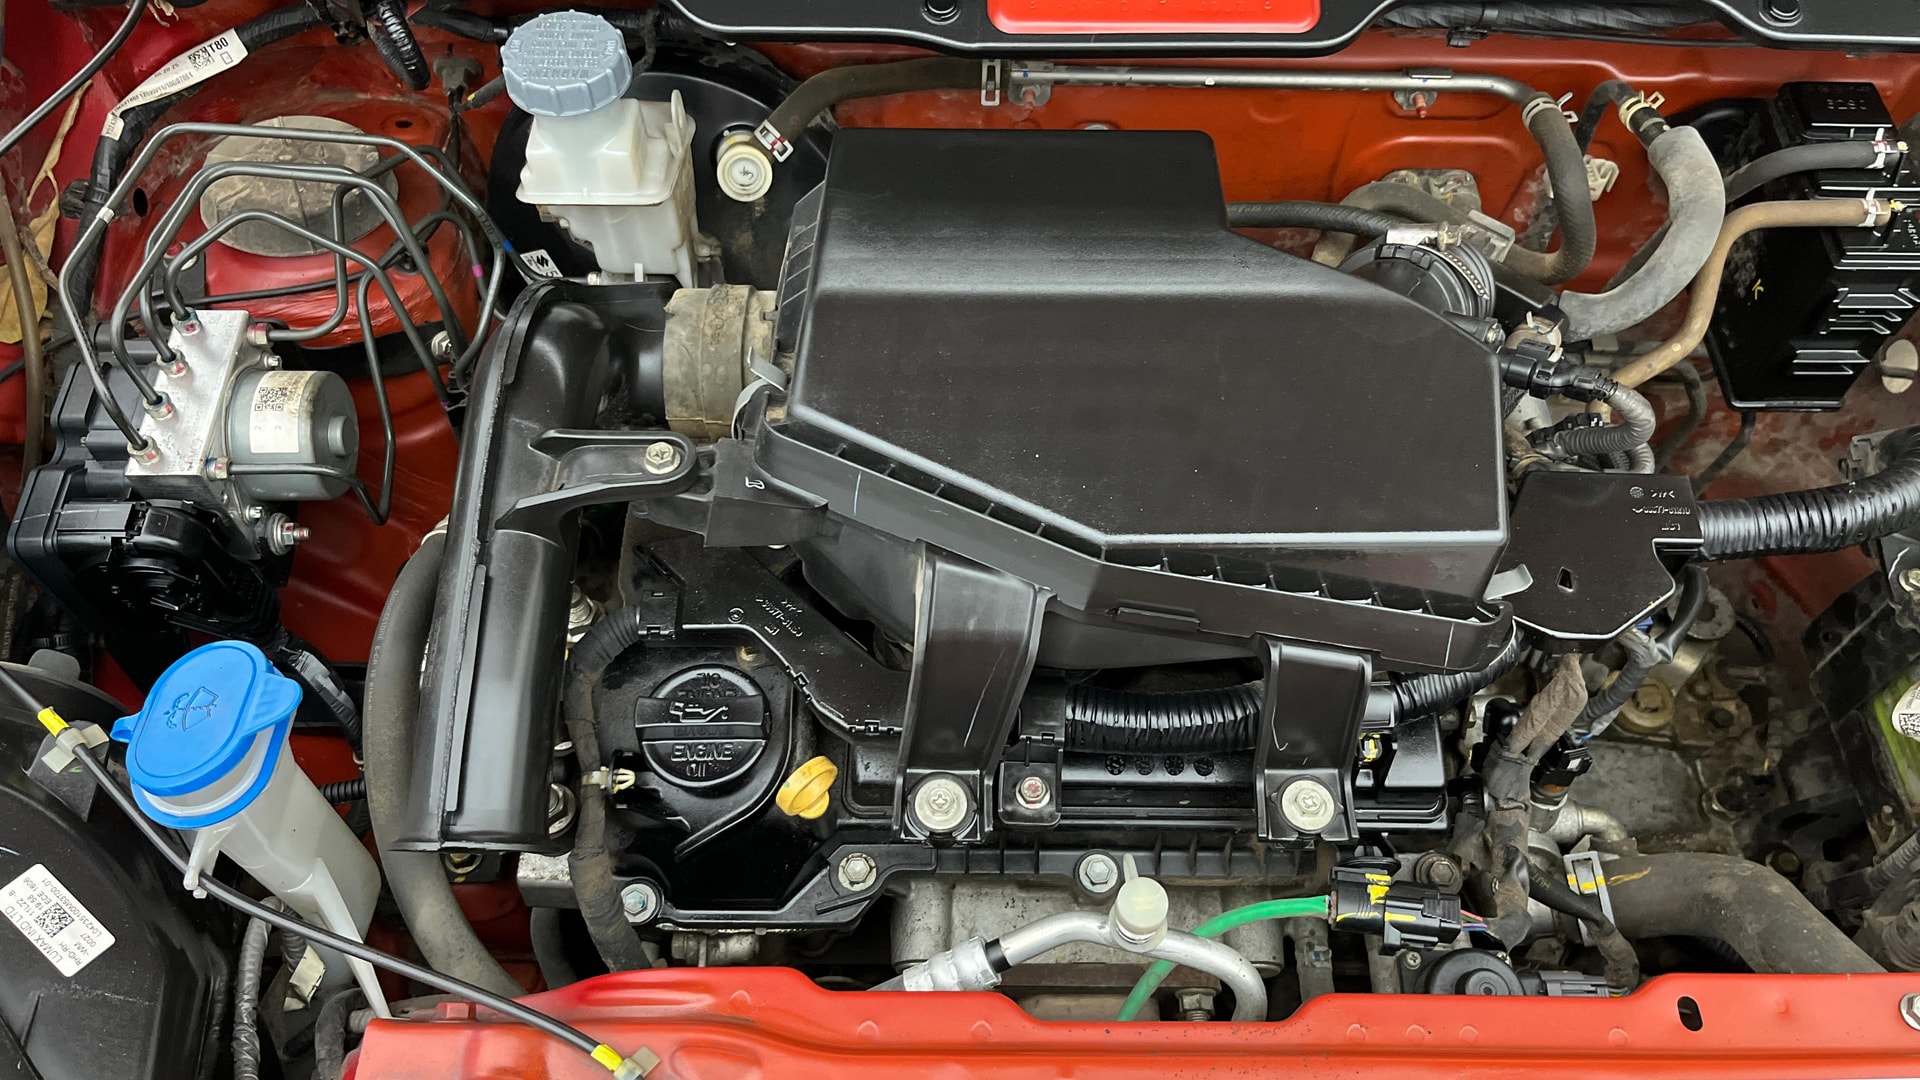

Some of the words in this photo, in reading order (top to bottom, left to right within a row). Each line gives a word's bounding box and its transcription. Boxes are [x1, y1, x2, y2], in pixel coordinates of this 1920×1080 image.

[208, 36, 229, 54] T80
[671, 743, 734, 762] ENGINE
[37, 890, 52, 905] ECE
[5, 905, 23, 923] LTD
[20, 920, 37, 938] IND
[34, 933, 63, 963] LUMAX
[58, 941, 82, 966] RHD-RH
